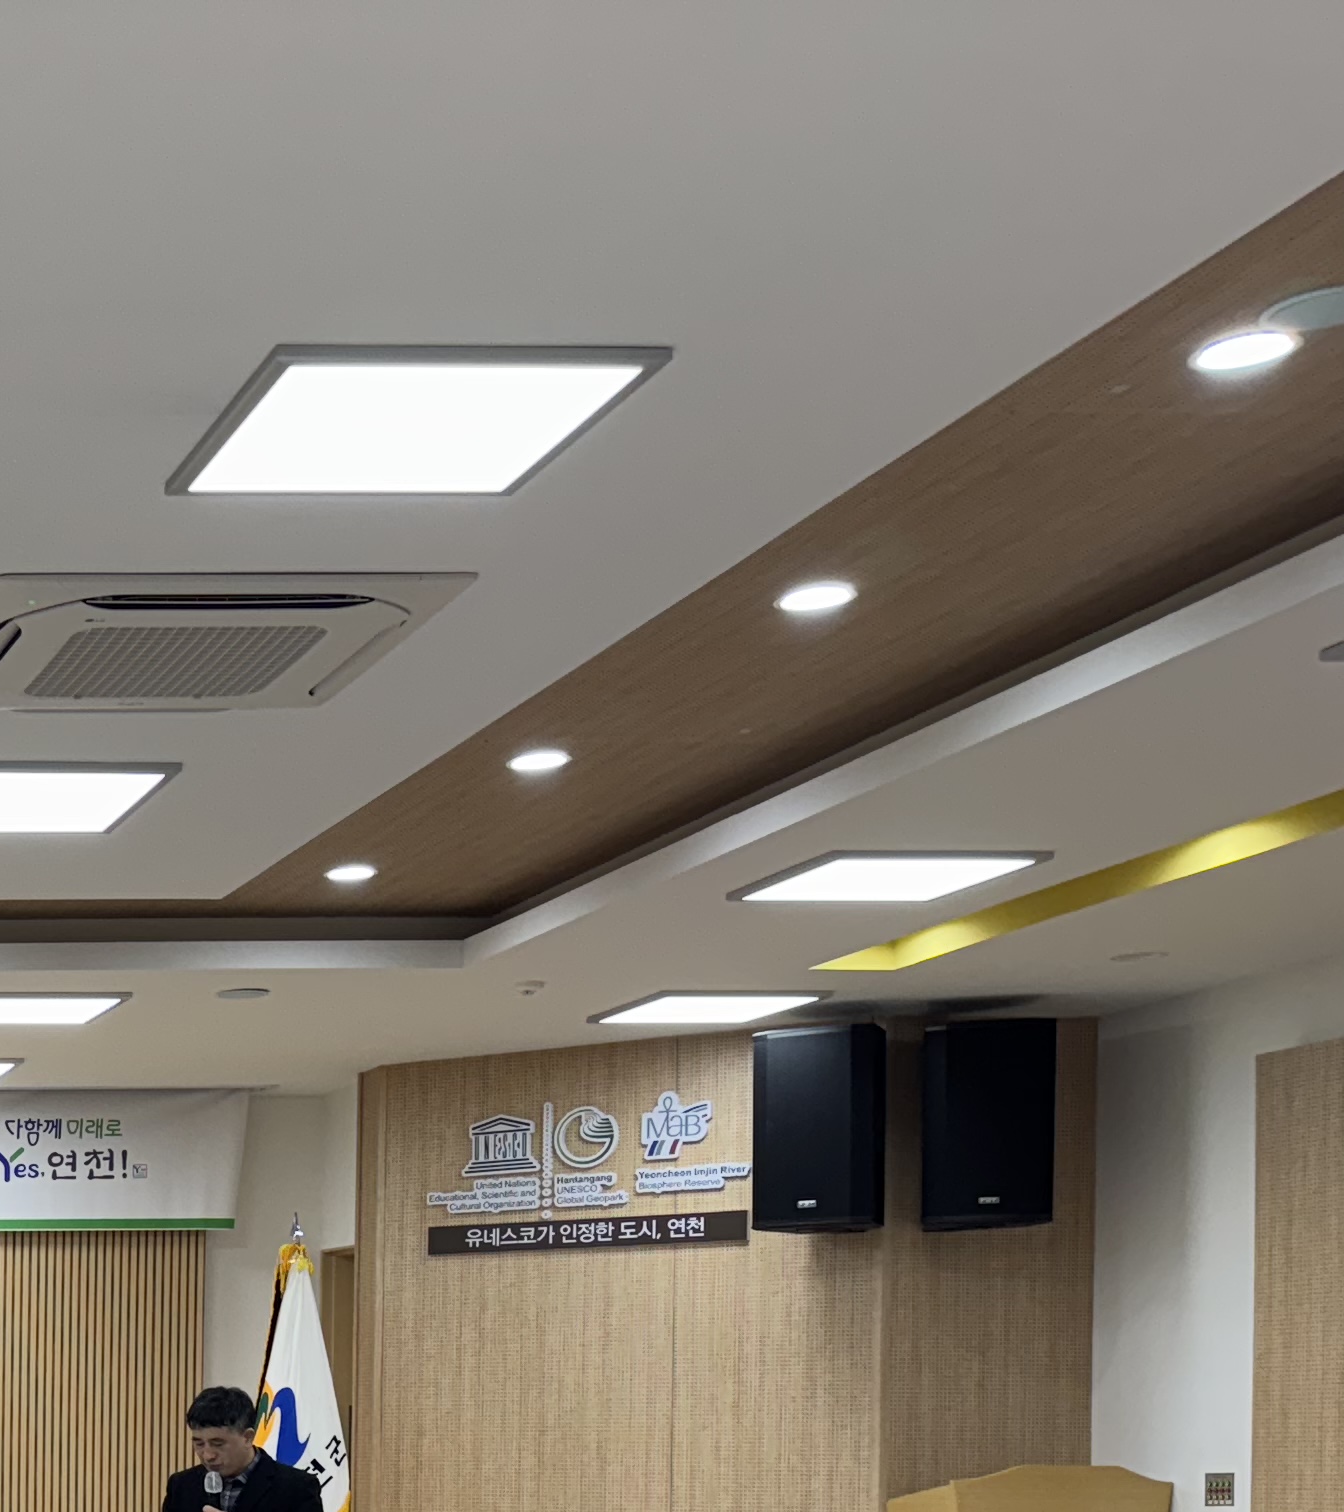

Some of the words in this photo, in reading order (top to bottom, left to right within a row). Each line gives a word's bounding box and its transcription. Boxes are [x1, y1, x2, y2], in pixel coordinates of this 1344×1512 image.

[4, 1117, 62, 1147] 다함께
[66, 1117, 123, 1140] 미래로
[556, 1184, 598, 1195] UNESCO
[464, 1224, 555, 1248] 유네스코가
[559, 1221, 615, 1244] 인정한
[618, 1219, 662, 1240] 도시,
[667, 1216, 705, 1239] 연천
